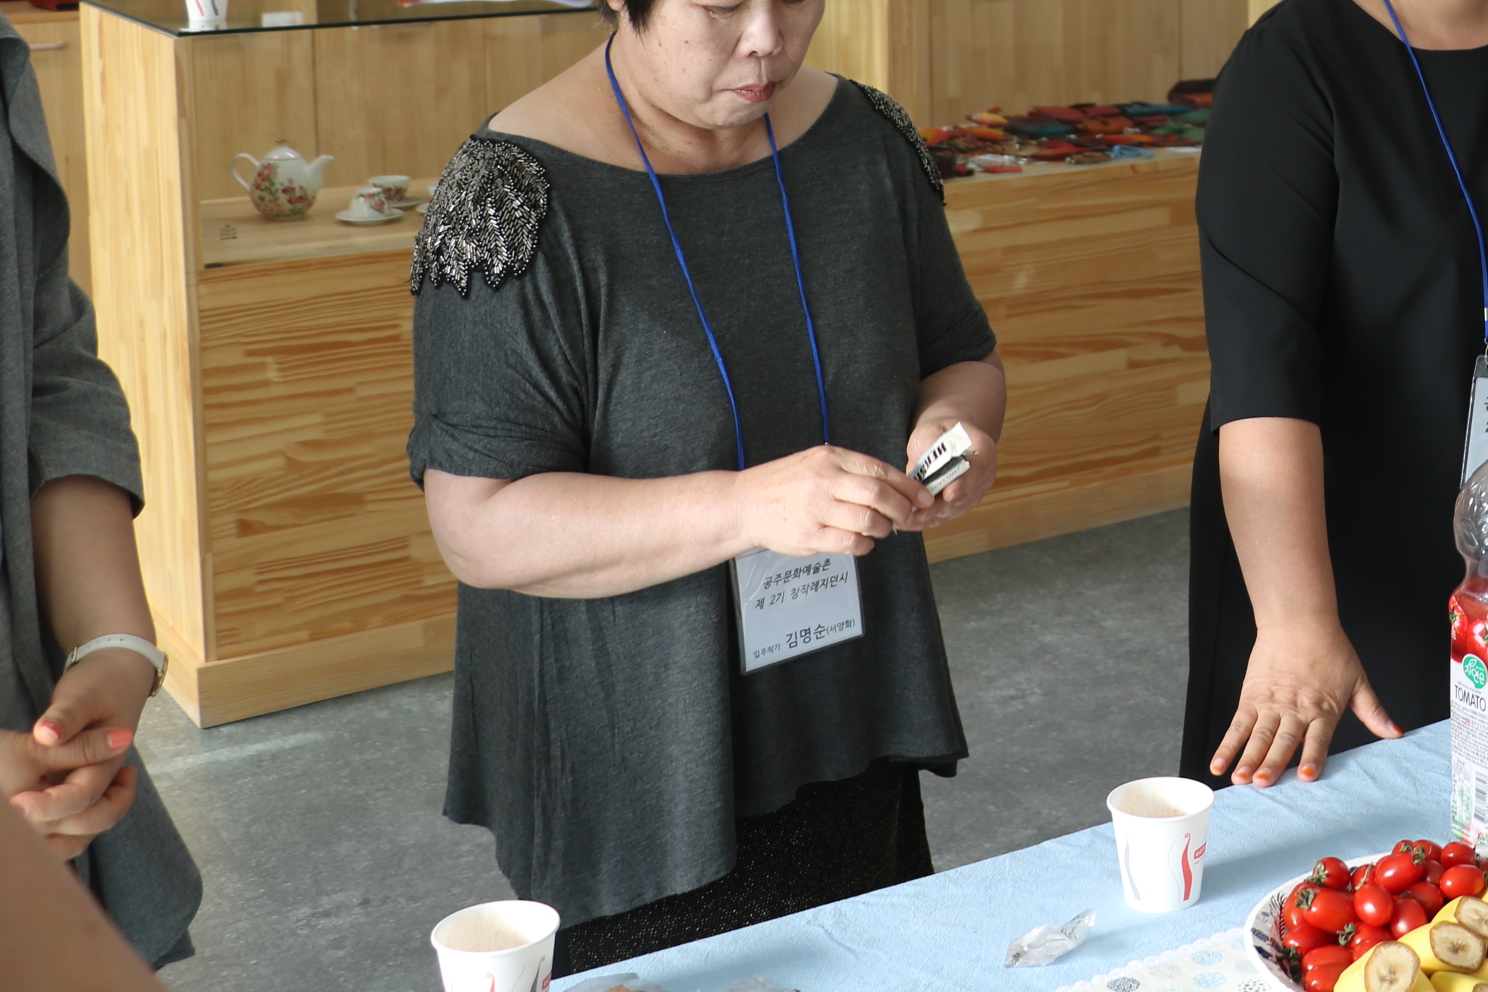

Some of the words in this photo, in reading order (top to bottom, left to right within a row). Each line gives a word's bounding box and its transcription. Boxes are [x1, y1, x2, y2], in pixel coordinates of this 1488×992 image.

[763, 558, 832, 590] 공주문화예술촌
[755, 597, 765, 610] 제
[769, 591, 785, 605] 2기
[790, 571, 849, 600] 창작레지던시
[753, 643, 781, 659] 입주작가
[1464, 664, 1485, 686] 자연은
[1454, 684, 1487, 712] TOMATO
